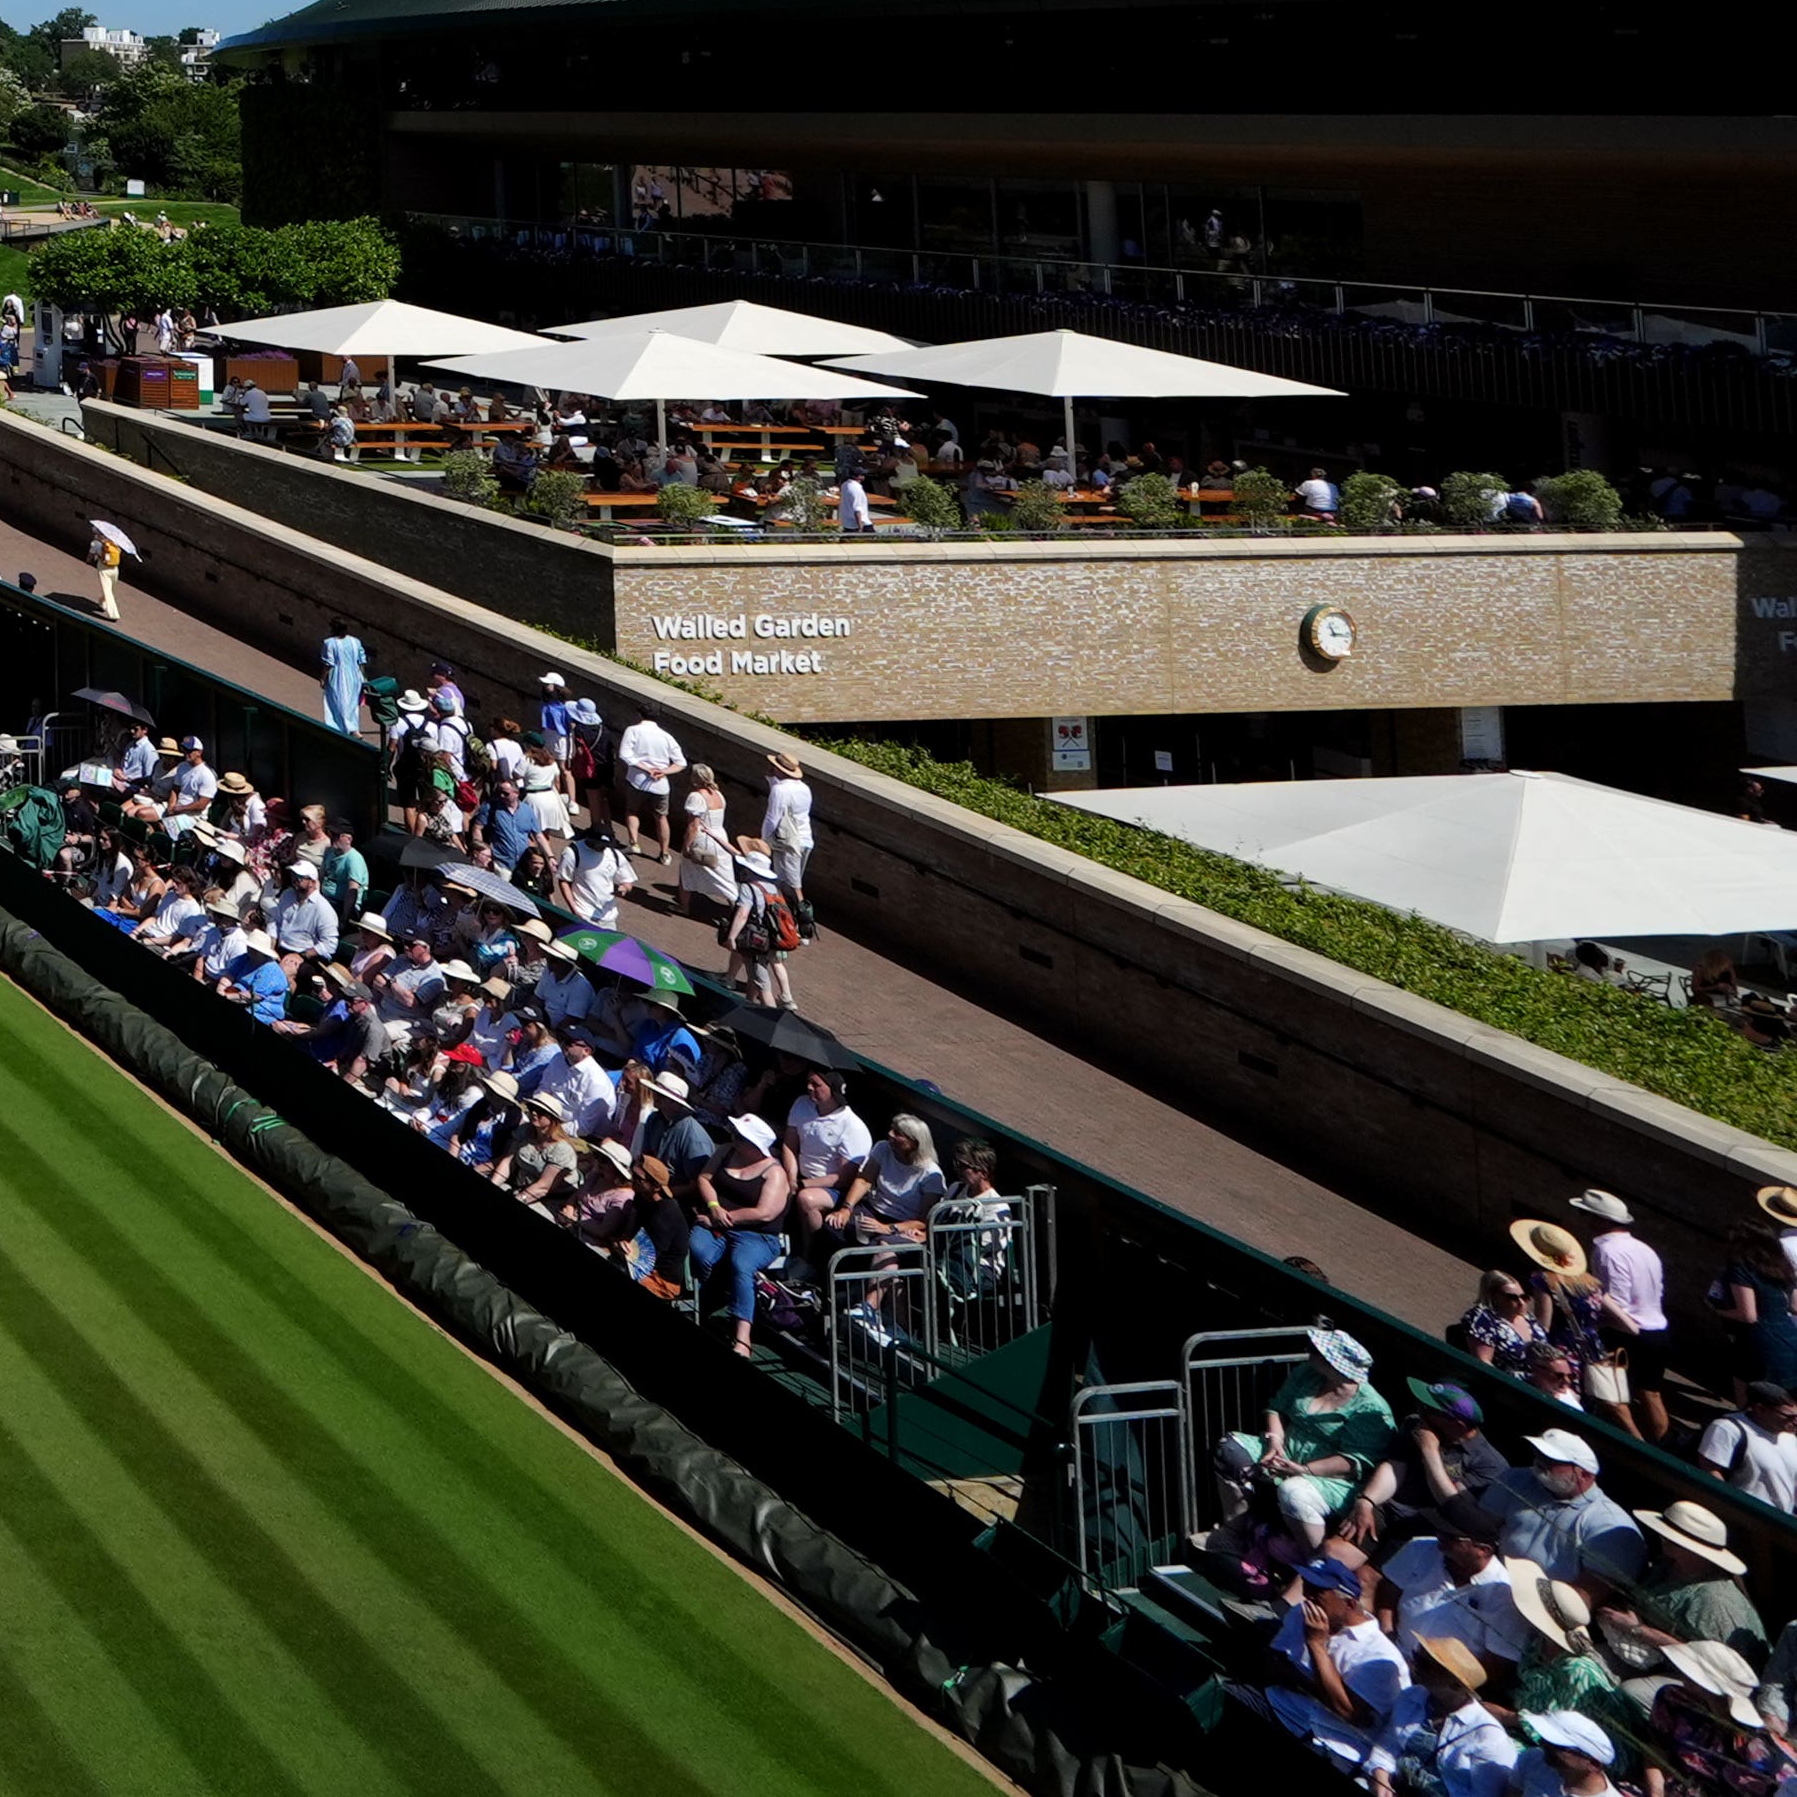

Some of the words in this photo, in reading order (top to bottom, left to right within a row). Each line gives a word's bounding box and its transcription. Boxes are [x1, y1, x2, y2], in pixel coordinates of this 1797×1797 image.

[652, 614, 746, 639] Walled
[754, 613, 851, 638] Garden
[653, 650, 723, 675] Food
[731, 650, 822, 674] Market
